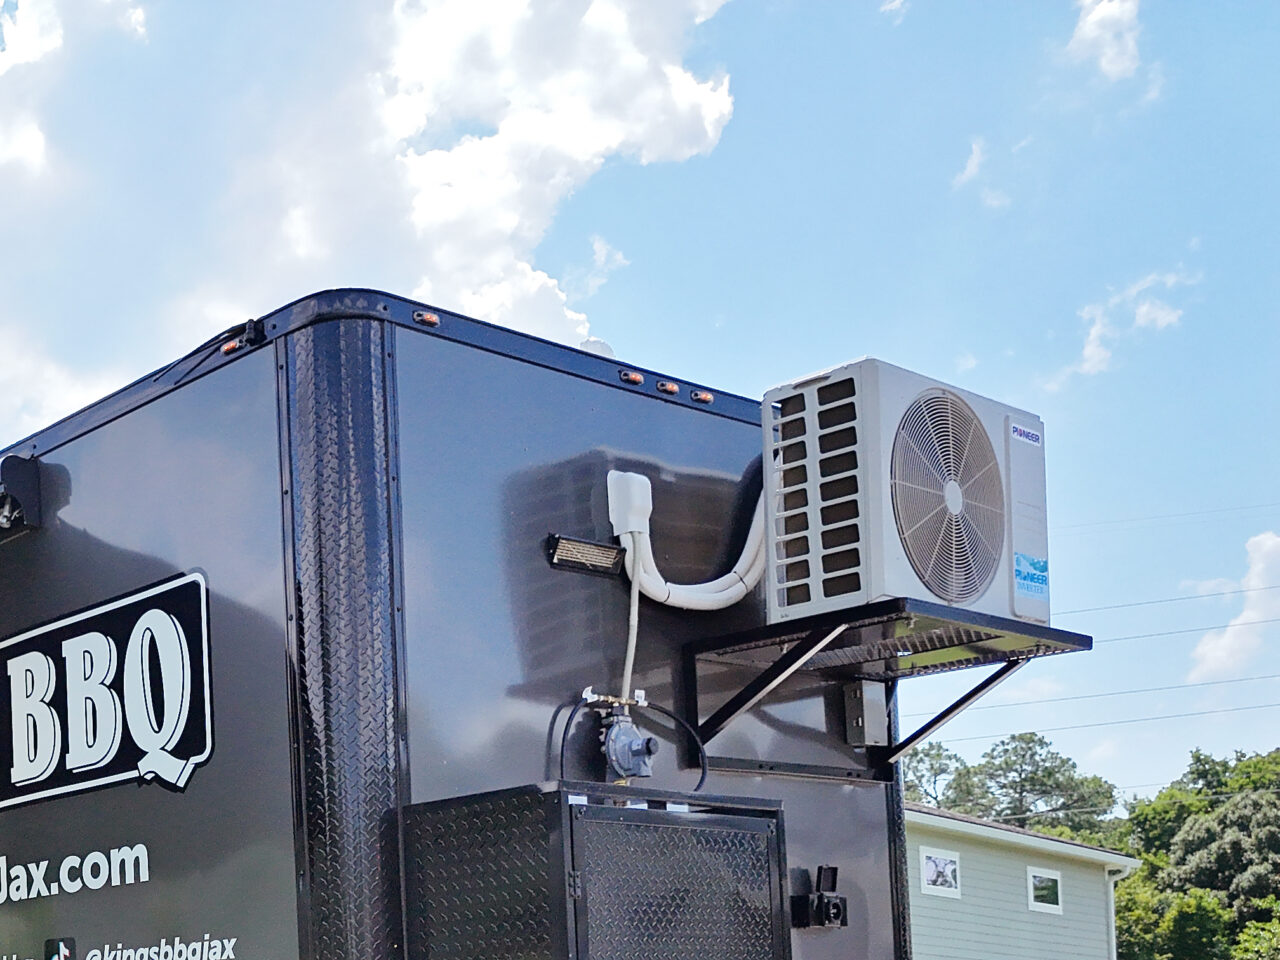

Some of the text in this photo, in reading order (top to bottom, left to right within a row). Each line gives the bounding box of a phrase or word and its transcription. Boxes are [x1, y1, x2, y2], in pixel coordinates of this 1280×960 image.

[1012, 425, 1040, 444] PIONEER
[1014, 568, 1048, 586] PIONEER
[7, 608, 195, 788] BBQ
